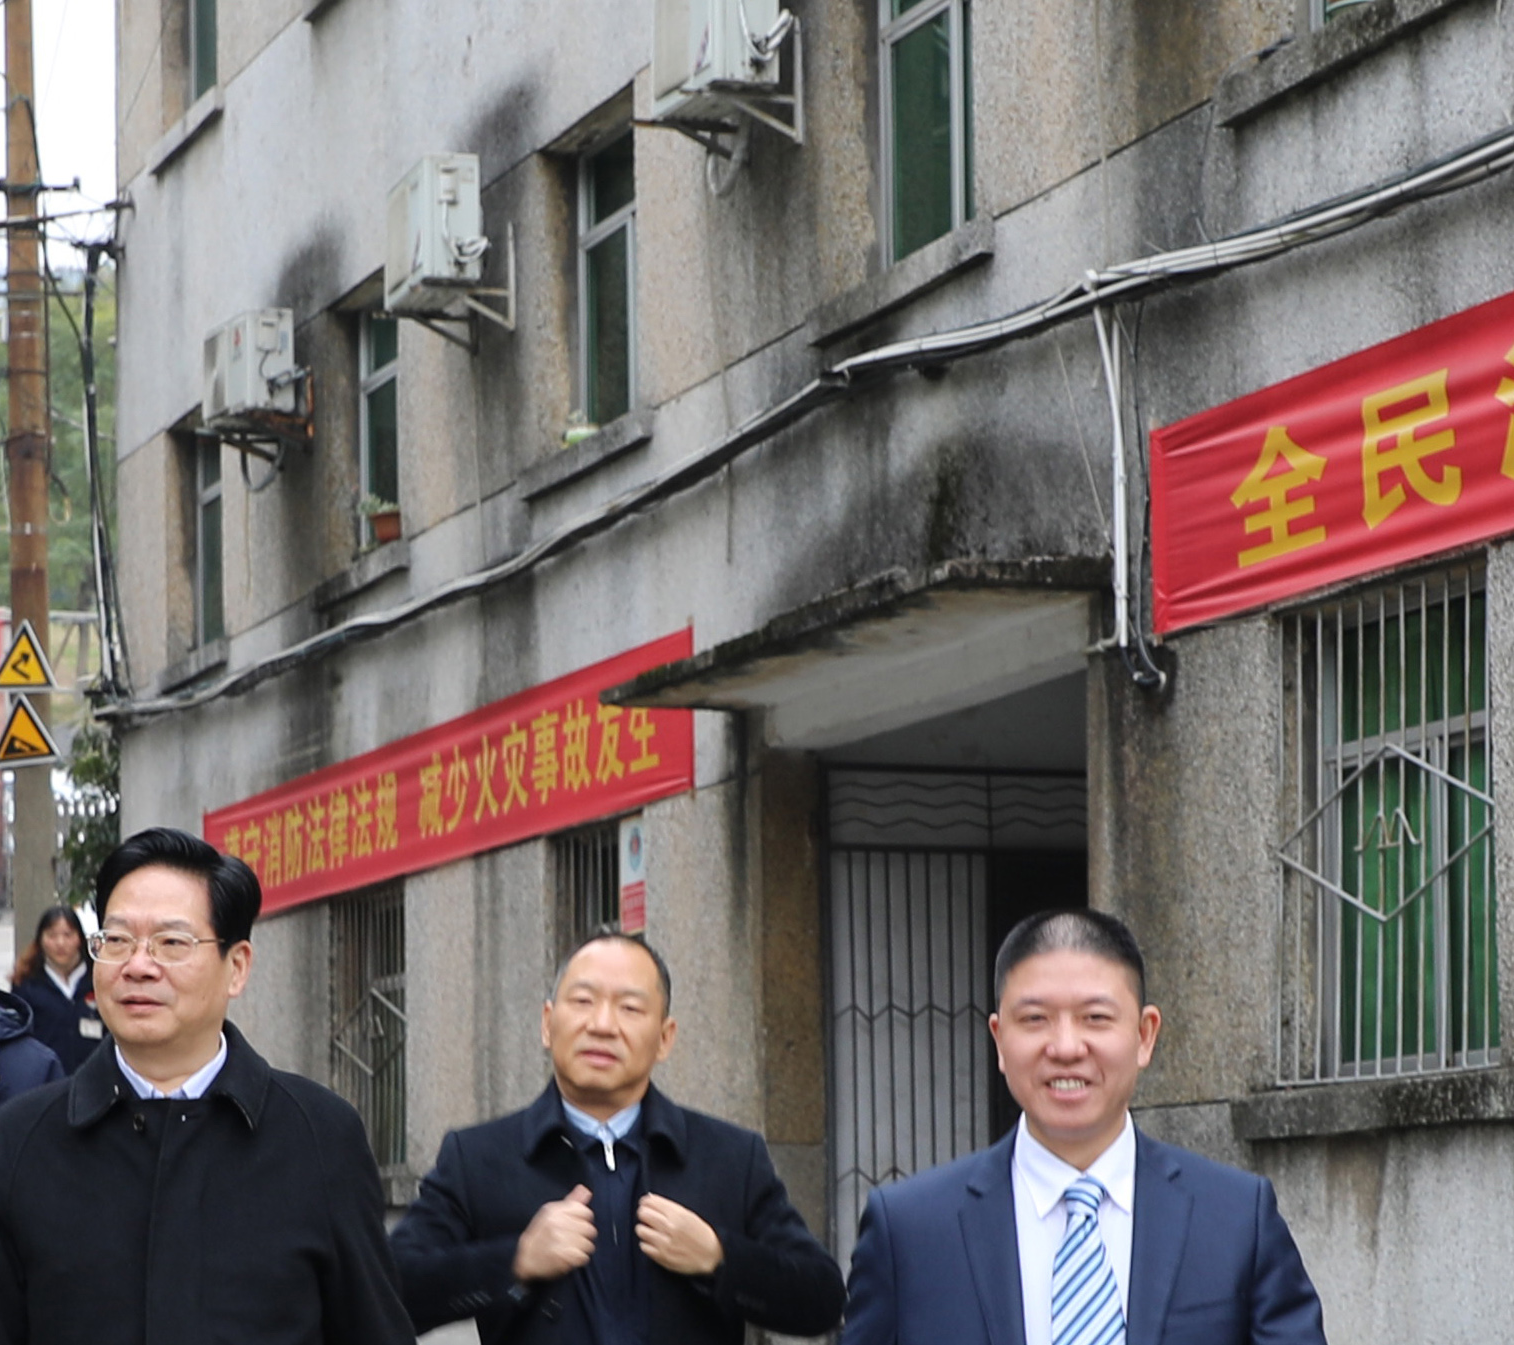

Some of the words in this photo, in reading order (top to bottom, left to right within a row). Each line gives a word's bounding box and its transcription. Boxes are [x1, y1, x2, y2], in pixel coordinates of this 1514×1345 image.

[1230, 343, 1514, 568] 全民
[418, 699, 660, 839] 减少火灾事故发生
